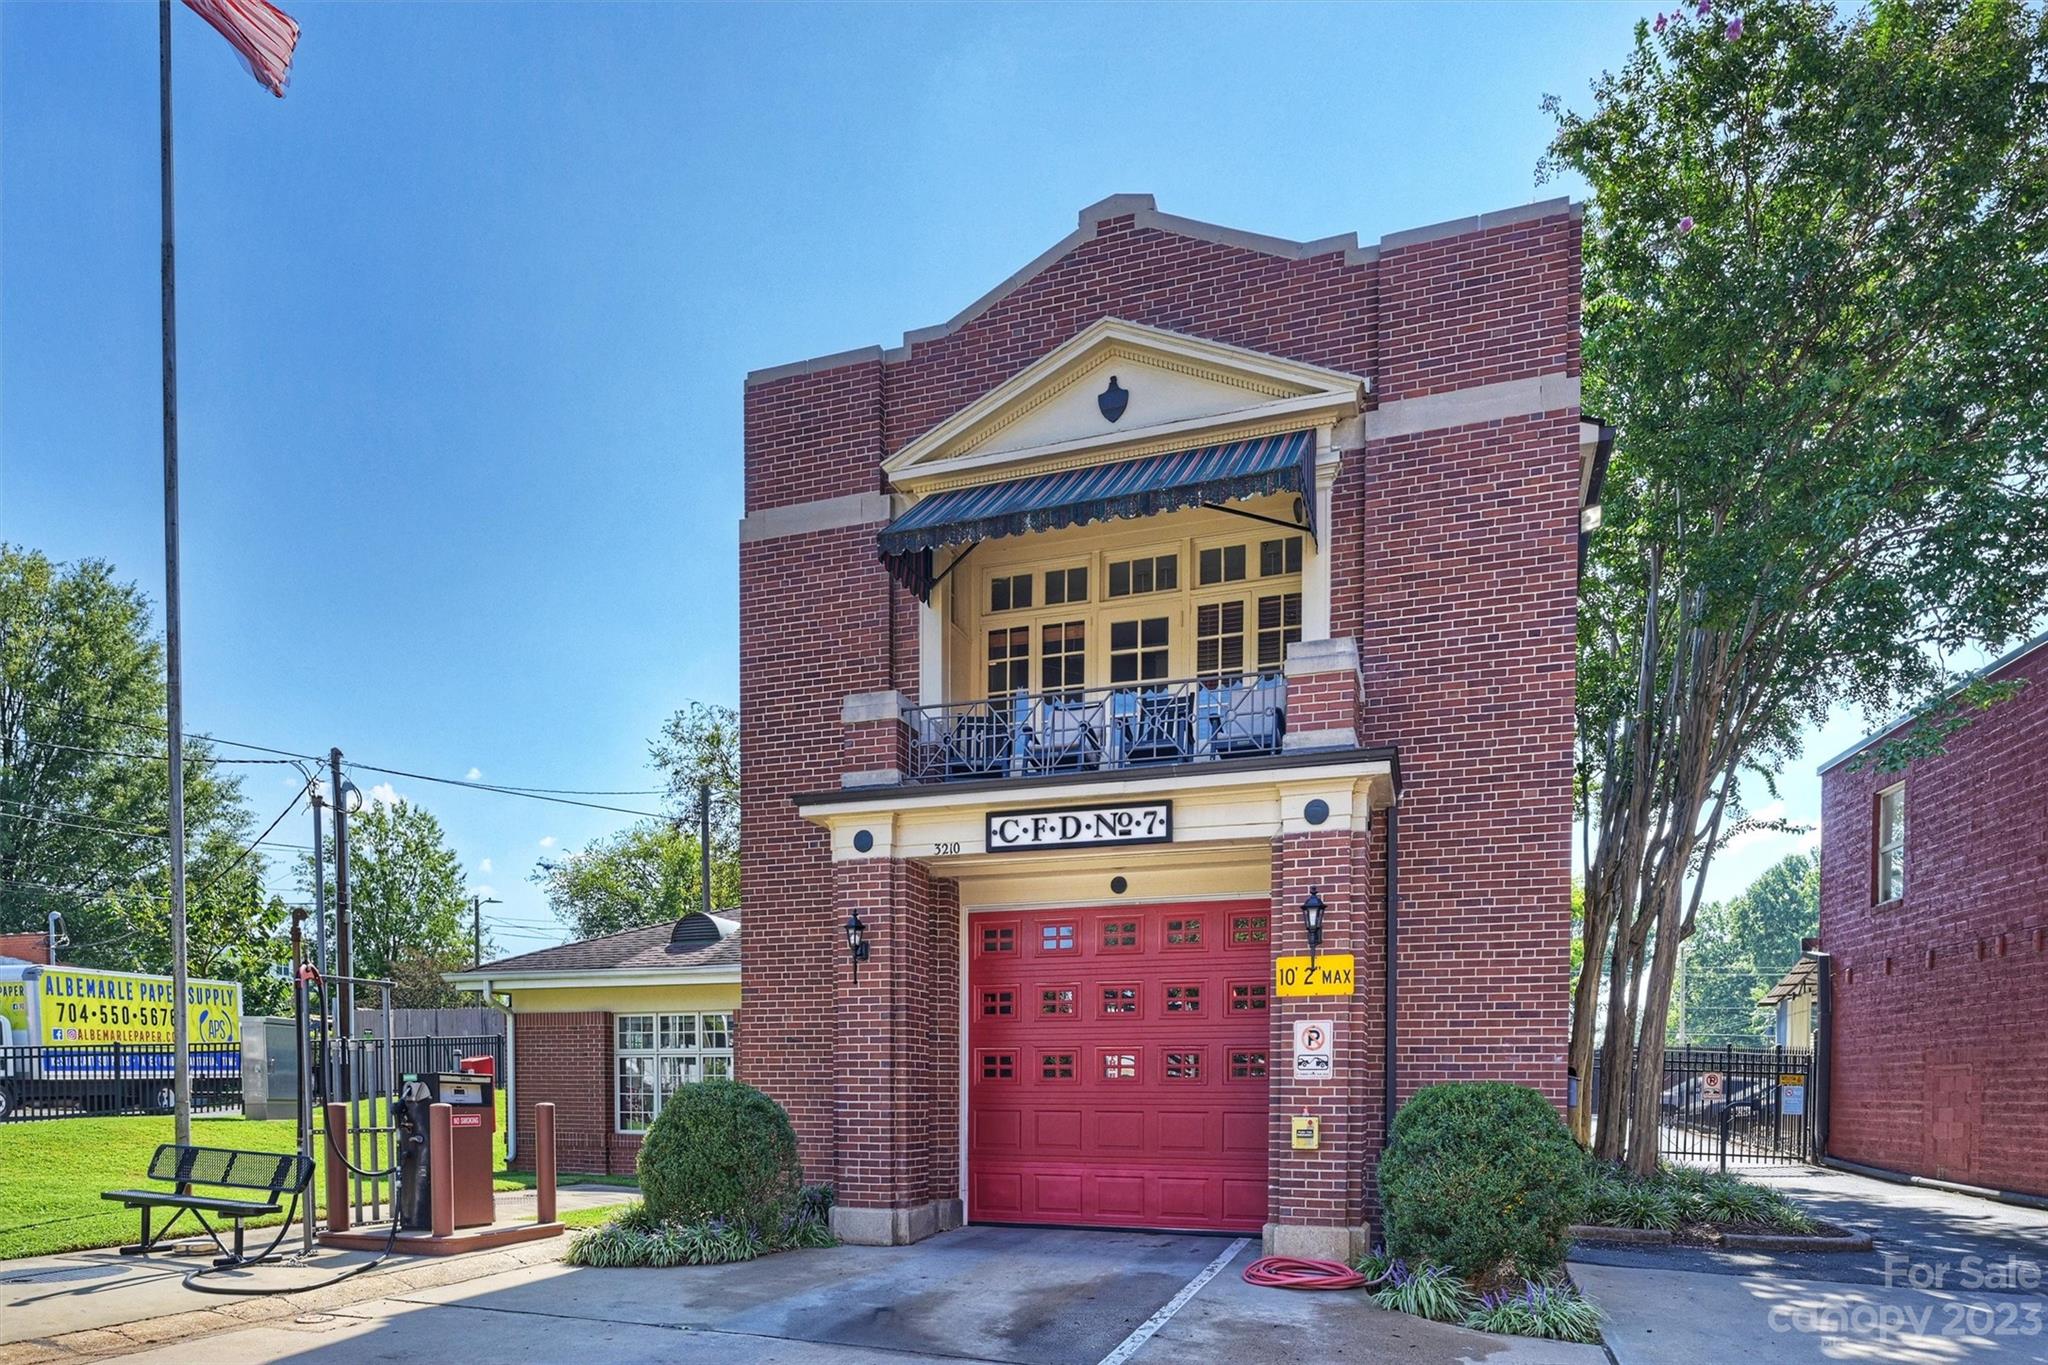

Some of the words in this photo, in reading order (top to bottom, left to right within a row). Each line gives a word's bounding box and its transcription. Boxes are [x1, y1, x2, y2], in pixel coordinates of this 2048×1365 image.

[934, 842, 961, 856] 3210
[1322, 969, 1351, 985] MAX
[46, 975, 133, 1001] ALBEMARLE
[140, 982, 174, 1003] PAPE
[188, 986, 233, 1007] SUPPLY
[208, 1019, 226, 1039] APS
